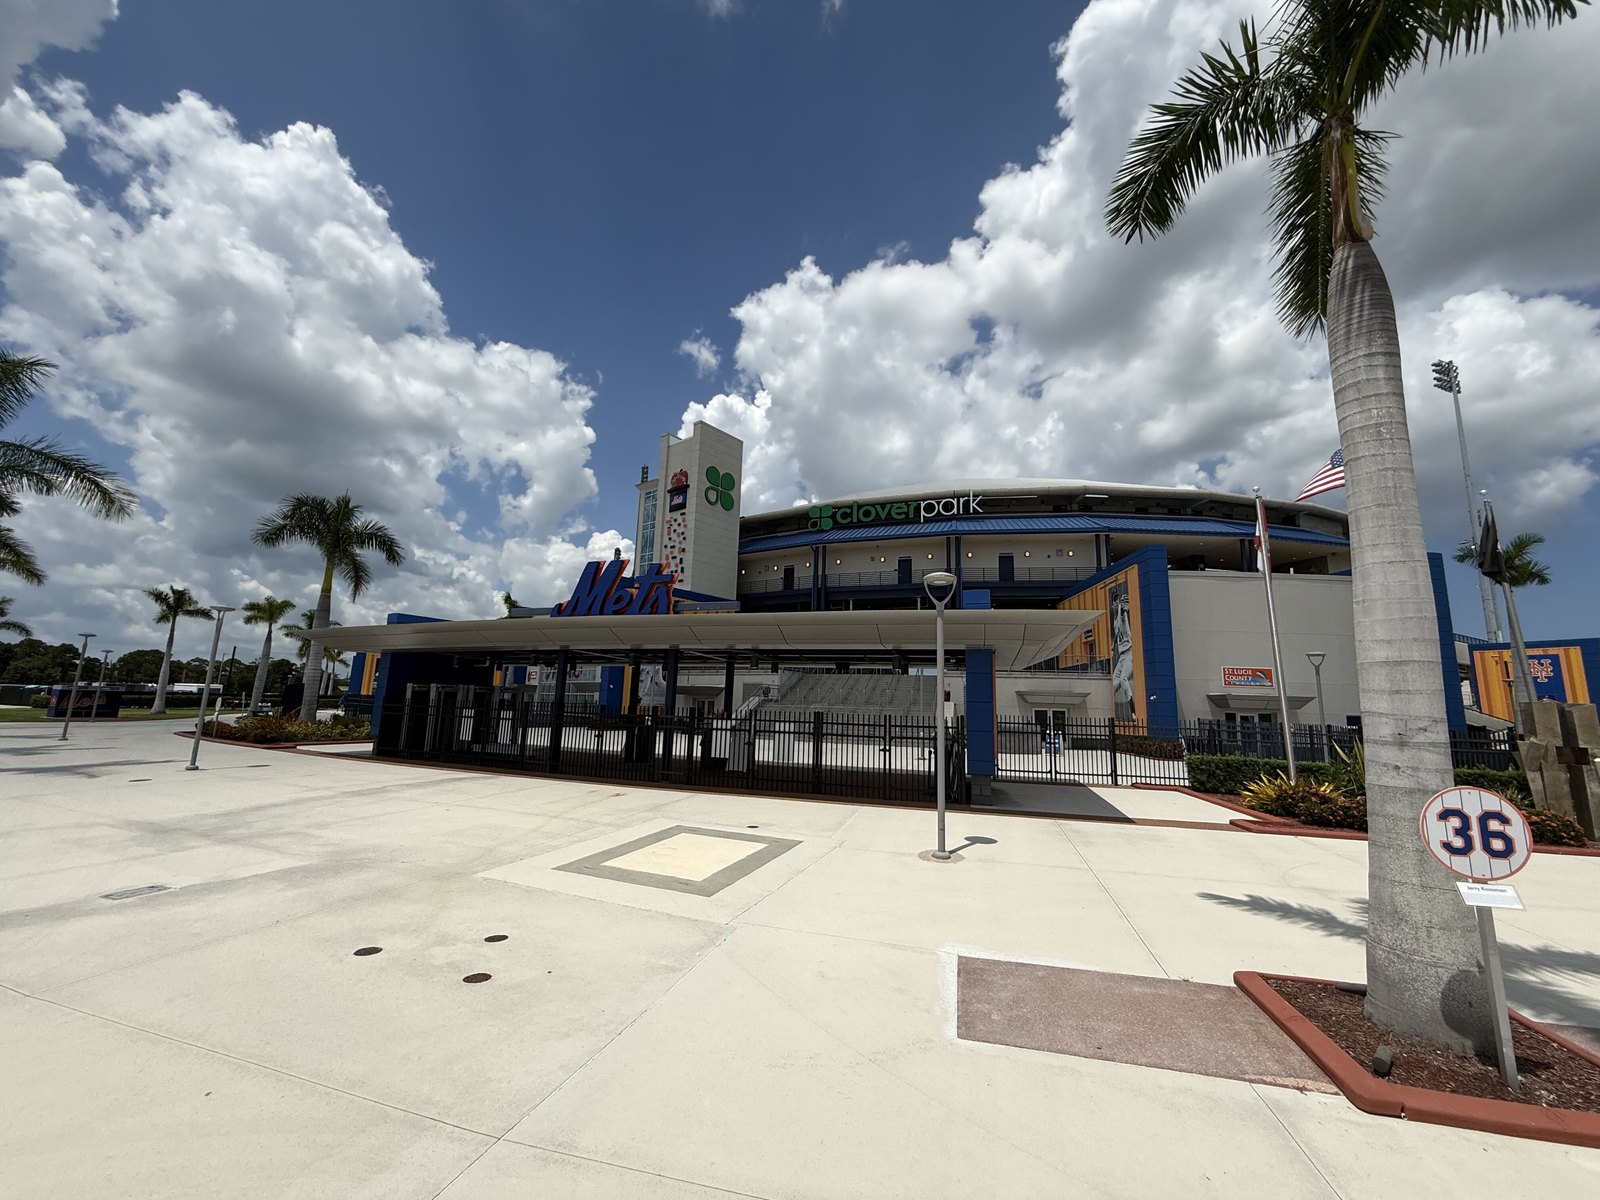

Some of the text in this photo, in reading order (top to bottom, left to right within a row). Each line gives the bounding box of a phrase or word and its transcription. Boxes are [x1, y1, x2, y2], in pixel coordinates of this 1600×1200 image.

[550, 560, 679, 617] Mets
[1224, 674, 1253, 682] COUNTY
[1234, 668, 1252, 676] LUCIE
[1436, 806, 1517, 861] 36
